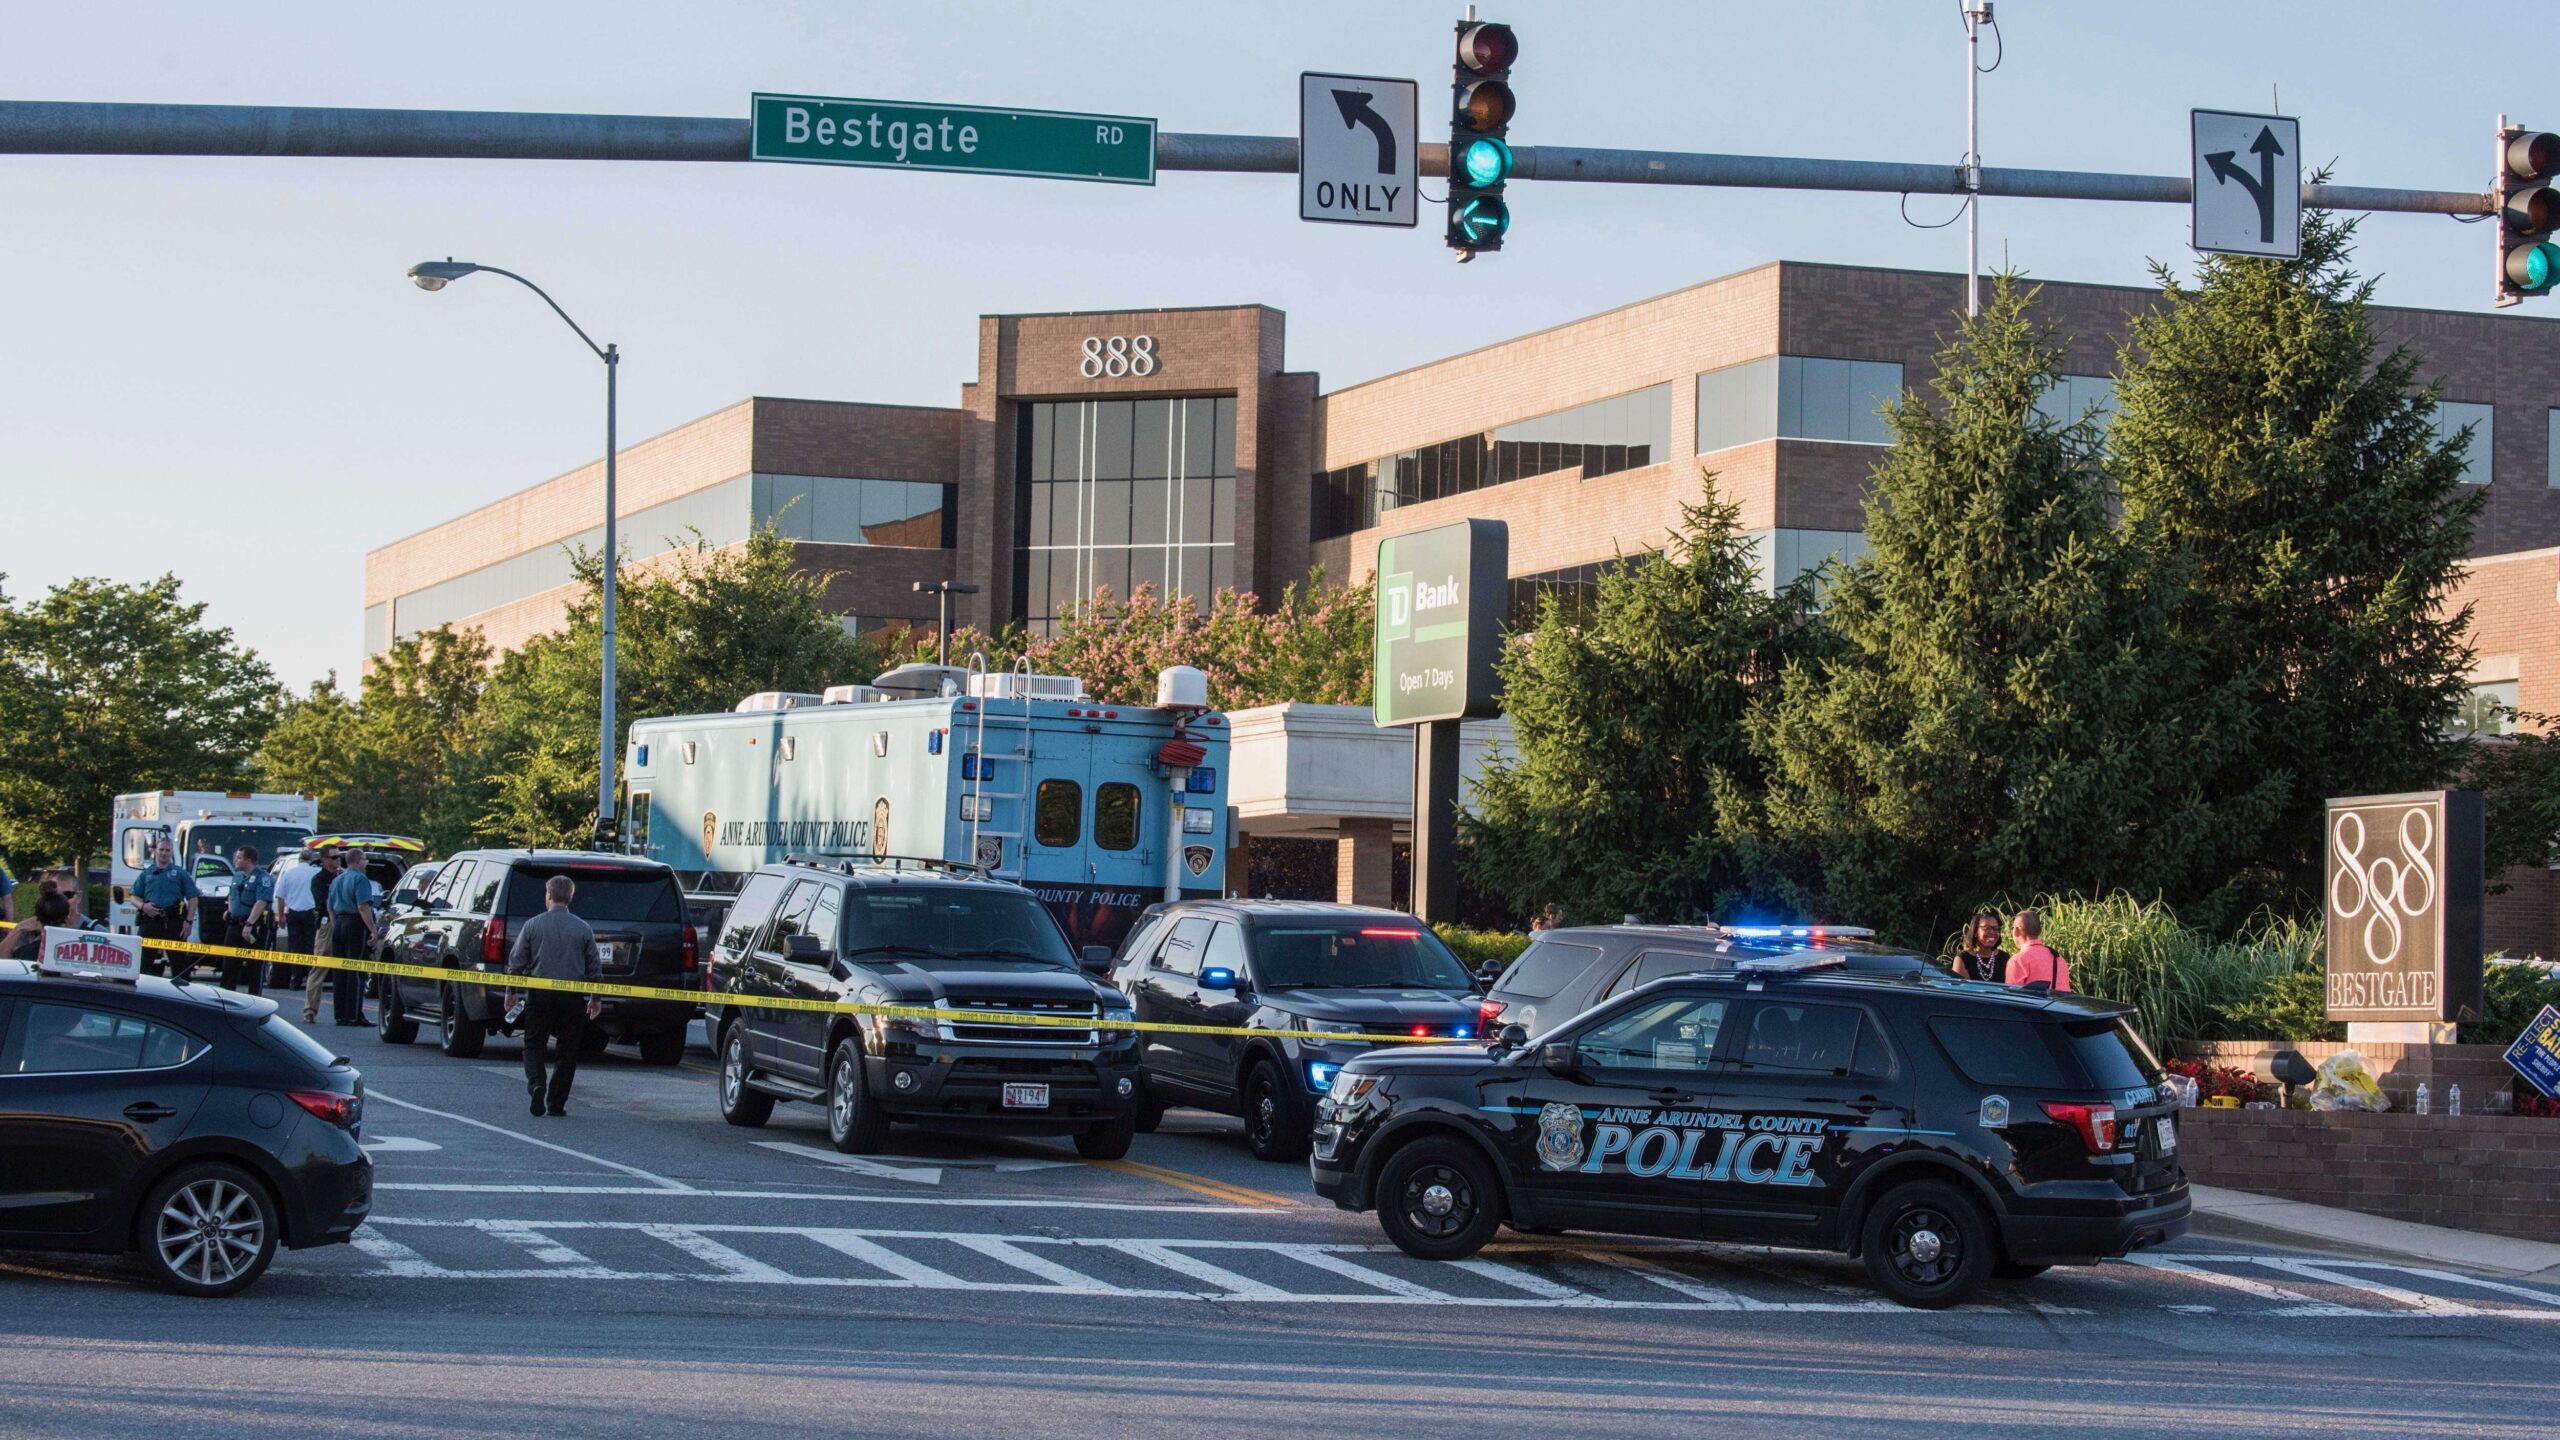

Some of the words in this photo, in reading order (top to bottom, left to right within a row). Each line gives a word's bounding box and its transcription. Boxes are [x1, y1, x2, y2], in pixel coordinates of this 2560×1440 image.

[785, 107, 979, 161] Bestgate
[1096, 126, 1124, 145] RD
[1317, 181, 1401, 212] ONLY
[1080, 335, 1154, 378] 888
[1388, 585, 1409, 626] TD
[1416, 575, 1459, 611] Bank
[1400, 672, 1423, 695] Open
[1424, 668, 1430, 688] 7
[1432, 668, 1454, 690] Days
[720, 821, 744, 846] ANNE
[744, 821, 789, 847] ARUNDEL
[790, 821, 830, 848] COUNTY
[830, 821, 869, 848] POLICE
[1089, 891, 1142, 907] POLICE
[2331, 807, 2435, 964] 888
[56, 943, 88, 961] PAPA
[2329, 971, 2435, 1008] BESTGATE
[2512, 1010, 2555, 1060] RE-ELECT
[2125, 1088, 2157, 1105] COUNTY
[1598, 1107, 1652, 1124] ANNE
[1653, 1109, 1746, 1130] ARUNDEL
[1749, 1114, 1829, 1134] COUNTY
[1579, 1124, 1825, 1187] POLICE
